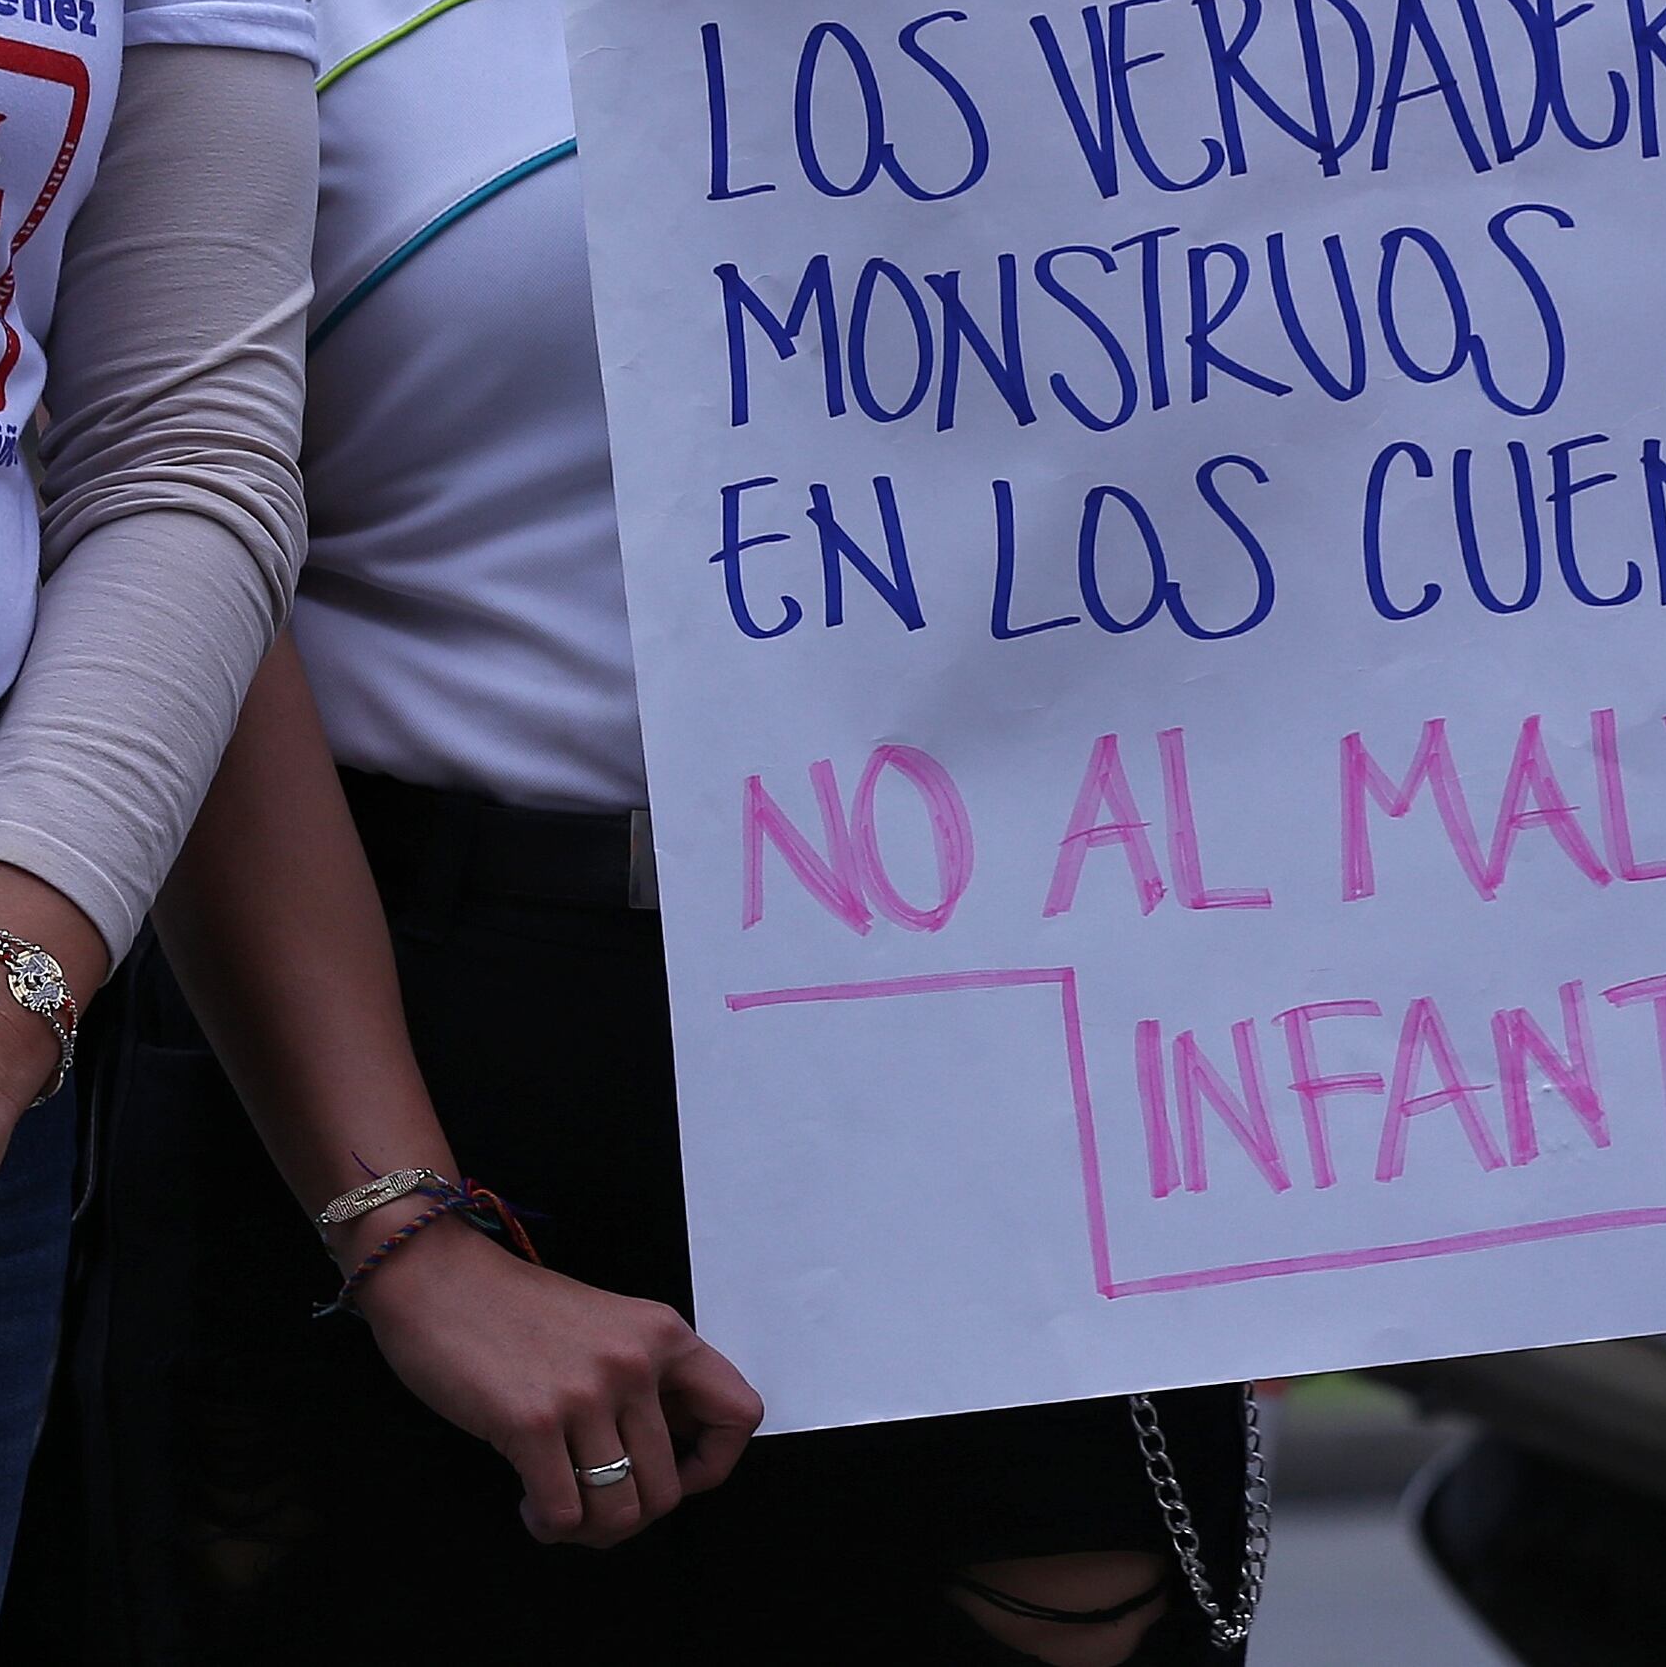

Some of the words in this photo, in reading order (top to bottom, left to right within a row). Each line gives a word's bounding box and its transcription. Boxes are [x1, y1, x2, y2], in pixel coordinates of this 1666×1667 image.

[702, 10, 990, 202] LOS
[715, 204, 1575, 432] MONSTRUOS
[709, 475, 926, 640] EN
[991, 454, 1275, 640] LOS
[743, 745, 972, 934] NO
[1044, 727, 1273, 916] AL
